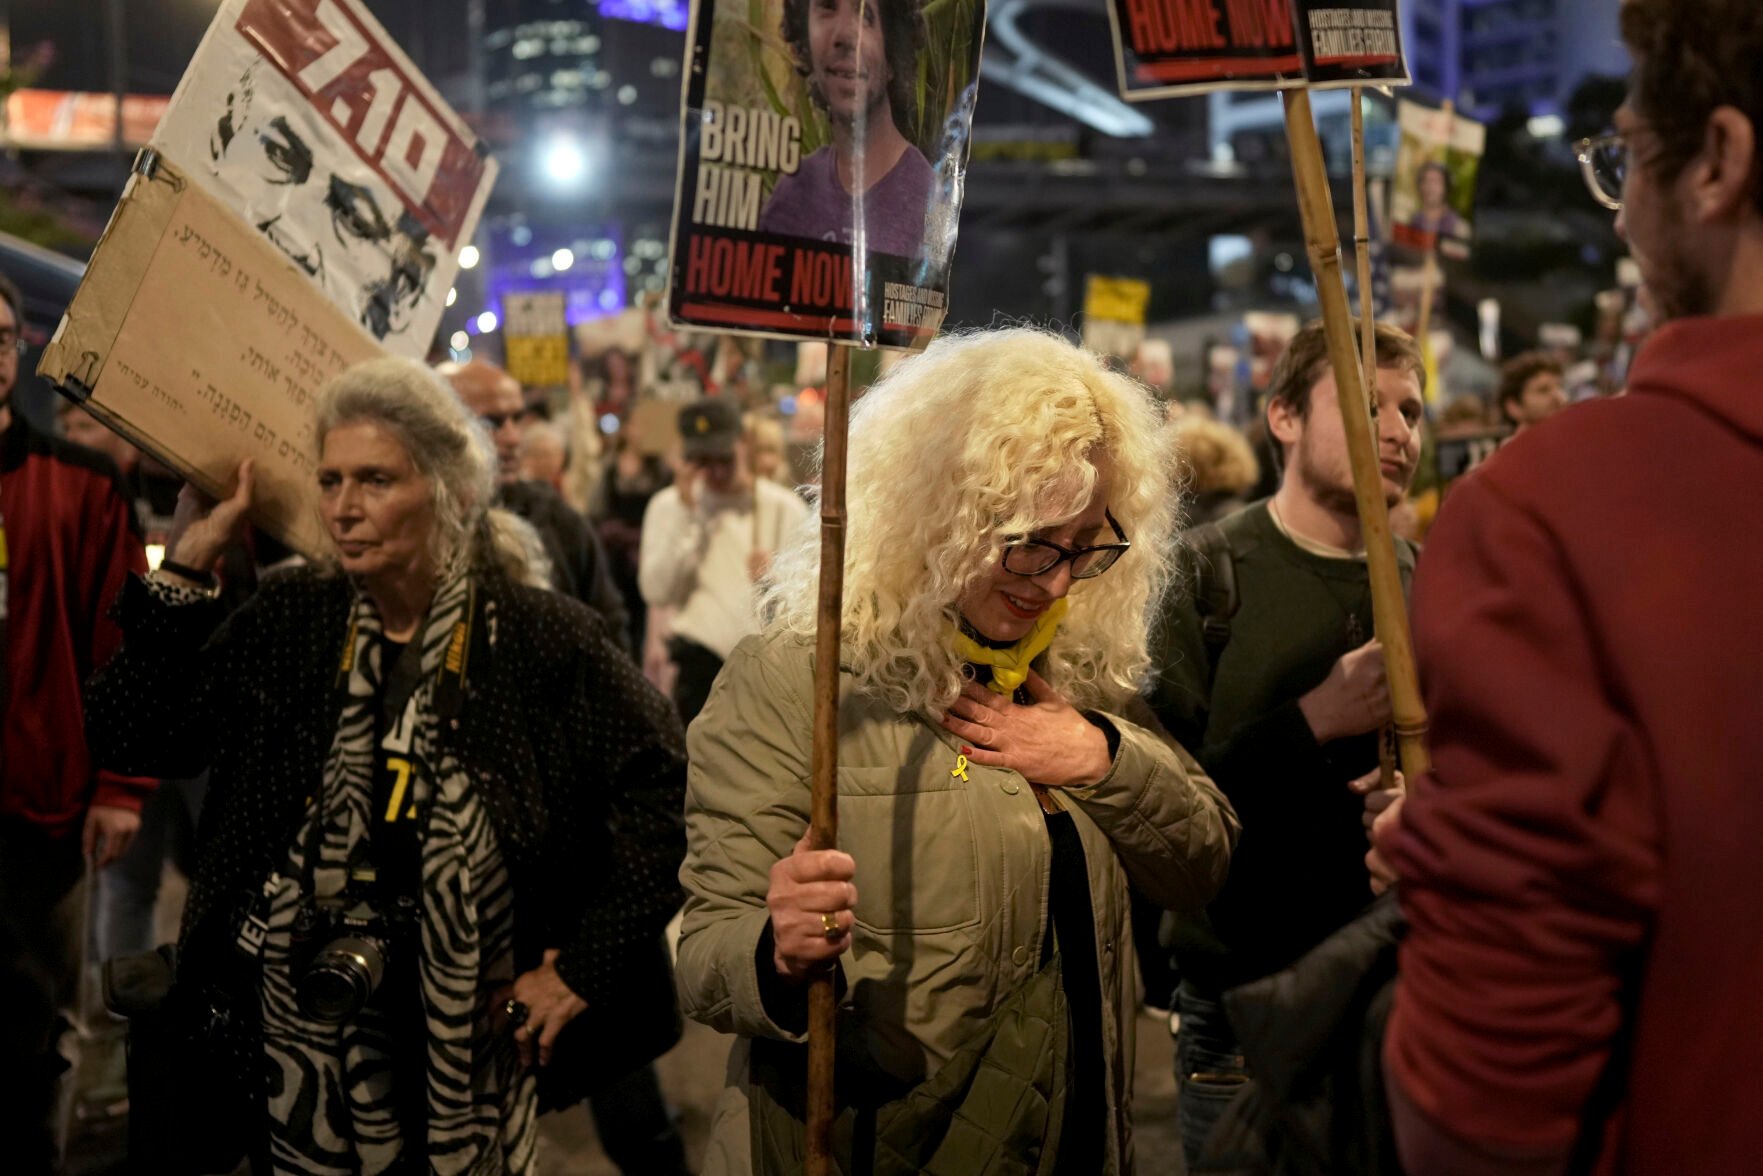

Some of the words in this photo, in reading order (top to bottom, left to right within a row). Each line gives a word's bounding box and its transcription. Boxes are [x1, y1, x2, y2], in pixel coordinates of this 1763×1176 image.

[1126, 0, 1226, 53] HOME
[1227, 0, 1294, 48] NOW
[1311, 28, 1365, 57] FAMILIES
[297, 0, 449, 206] 7.10
[701, 100, 799, 174] BRING
[692, 167, 762, 231] HIM
[686, 234, 785, 302] HOME
[790, 249, 862, 311] NOW
[883, 299, 923, 328] FAMILIES
